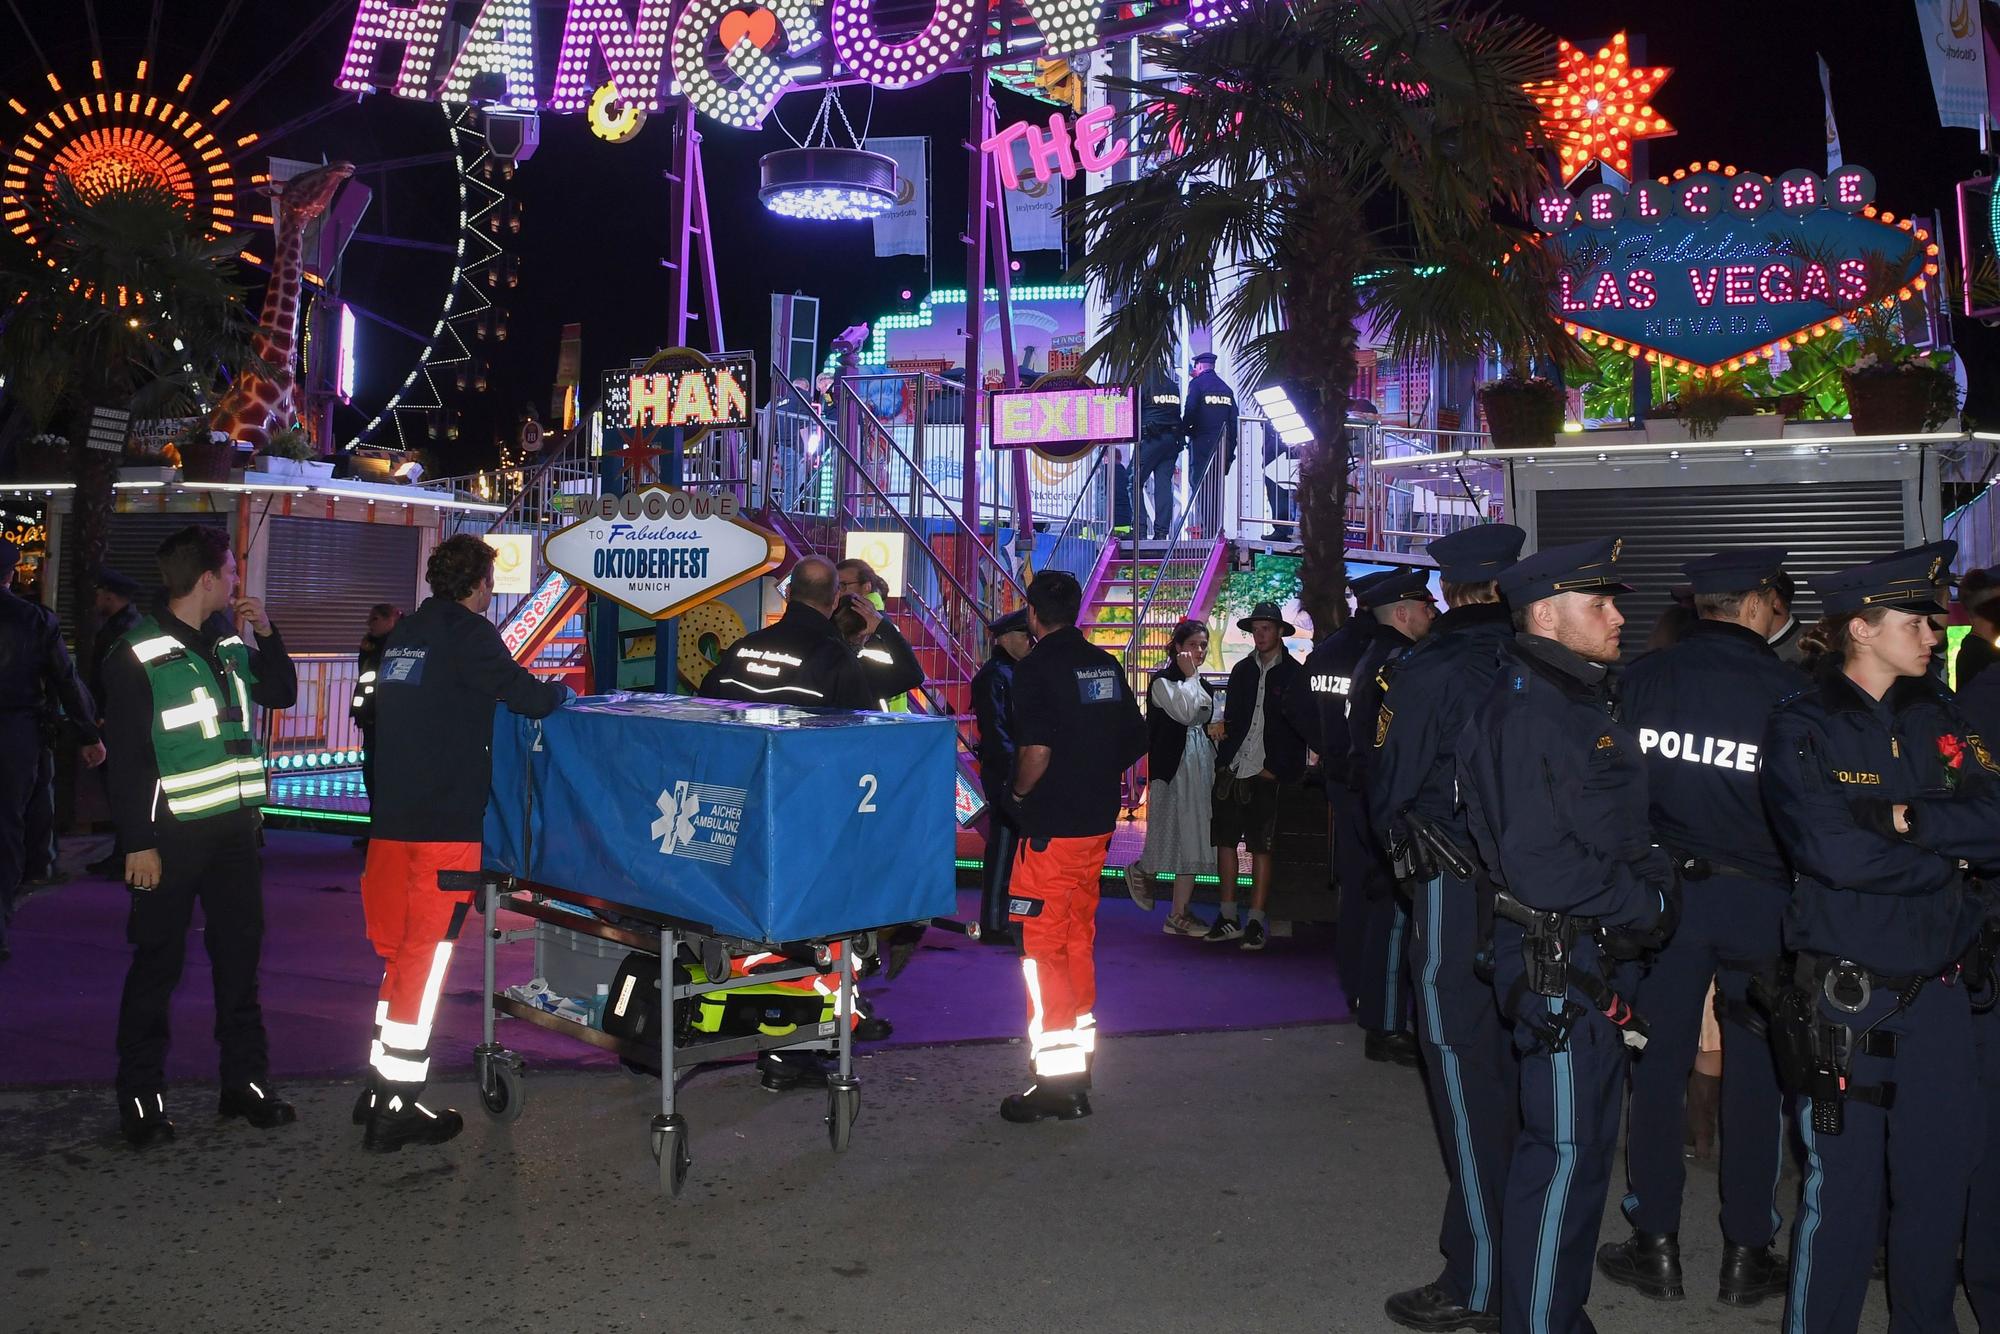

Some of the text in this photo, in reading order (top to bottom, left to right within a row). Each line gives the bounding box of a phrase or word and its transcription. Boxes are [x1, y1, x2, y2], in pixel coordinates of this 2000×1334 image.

[981, 104, 1128, 190] THE
[1538, 174, 1864, 223] WELCOME
[1579, 231, 1793, 271] TO Fabulous
[1559, 259, 1868, 312] LAS VEGAS
[1645, 314, 1772, 337] NEVADA
[629, 370, 747, 427] HAN
[1003, 395, 1127, 439] EXIT
[578, 498, 733, 516] WELCOME
[589, 524, 702, 544] TO Fabulous
[594, 547, 709, 579] OKTOBERFEST
[629, 582, 671, 592] MUNICH
[505, 599, 546, 652] asse
[402, 647, 426, 658] Service
[1077, 669, 1099, 679] Medical
[532, 719, 543, 752] 2
[1639, 728, 1762, 772] POLIZE
[858, 773, 878, 813] 2
[693, 815, 740, 833] AMBULANZ
[710, 804, 742, 820] AICHER
[710, 831, 737, 847] UNION
